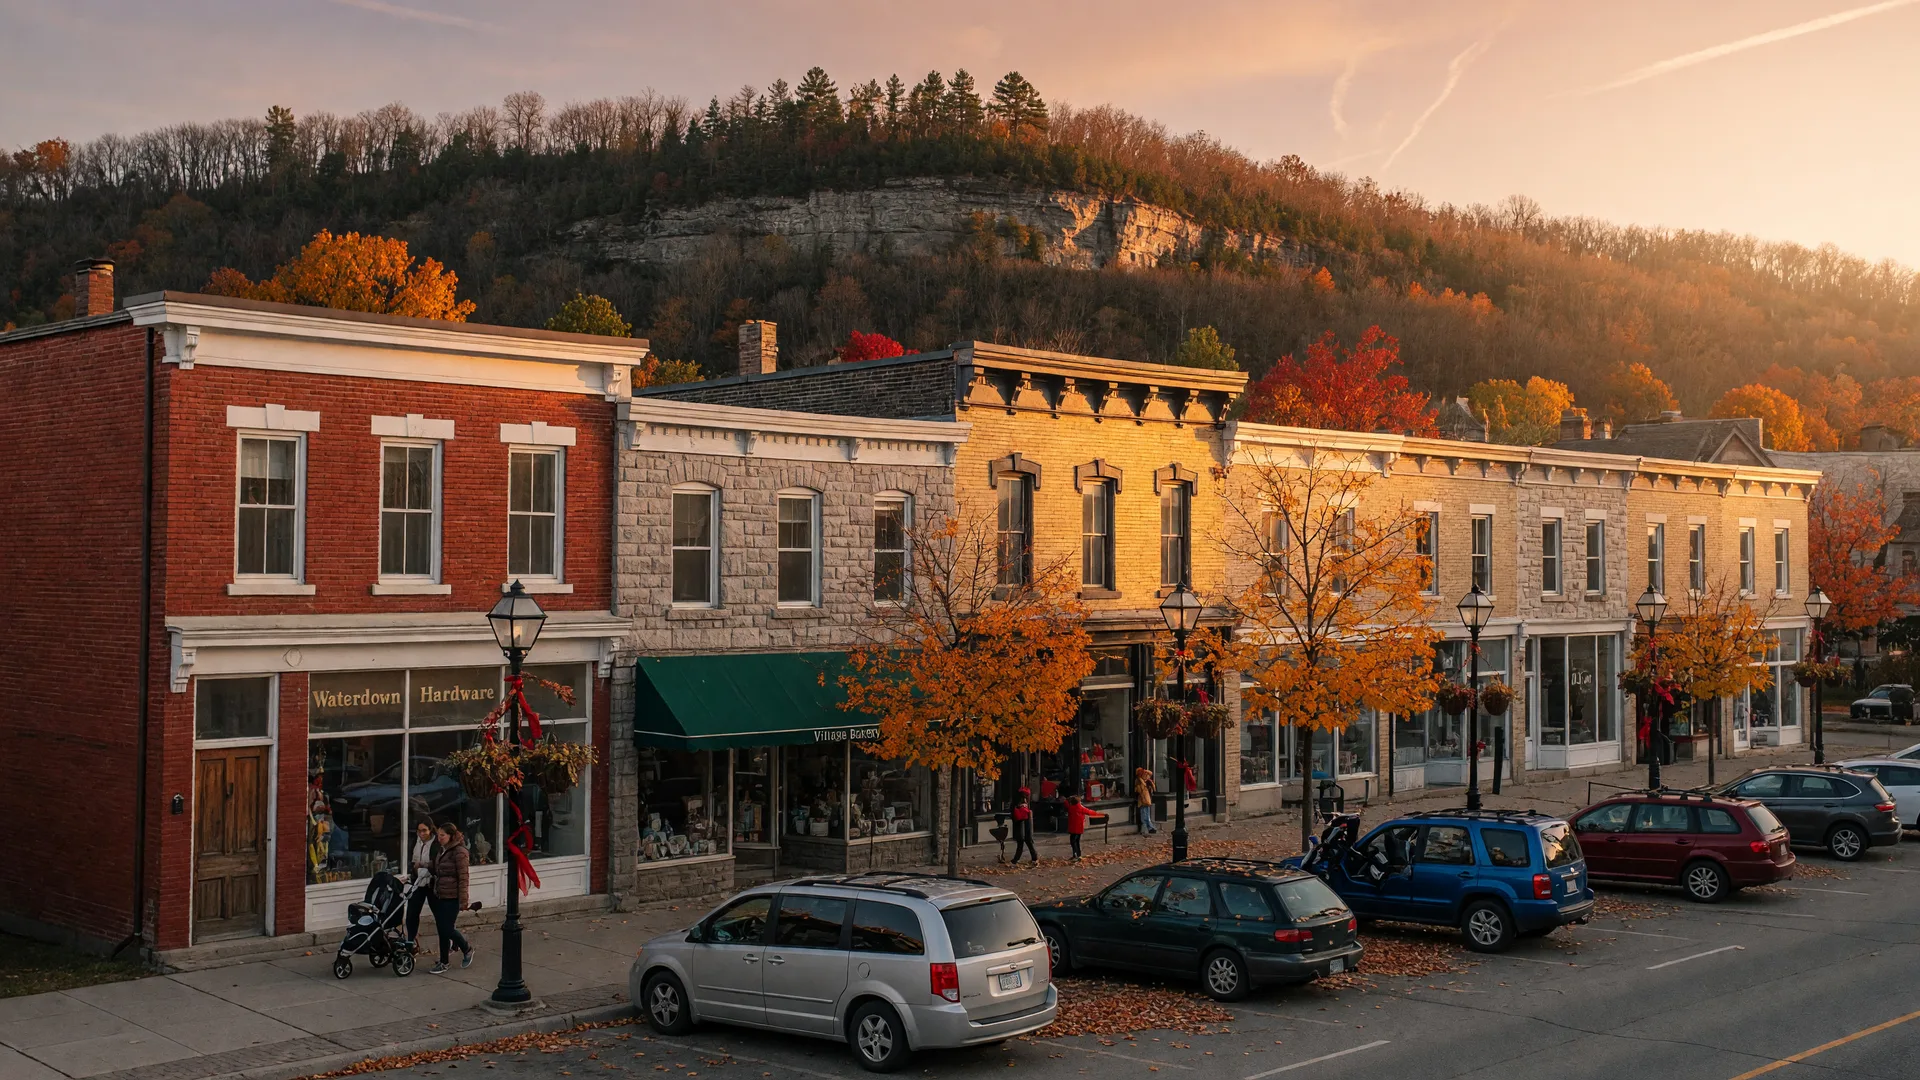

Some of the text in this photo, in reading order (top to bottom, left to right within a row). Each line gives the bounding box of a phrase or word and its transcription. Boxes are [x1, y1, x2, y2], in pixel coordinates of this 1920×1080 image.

[312, 685, 495, 708] Waterdown Hardware
[814, 728, 880, 742] Village Bakery
